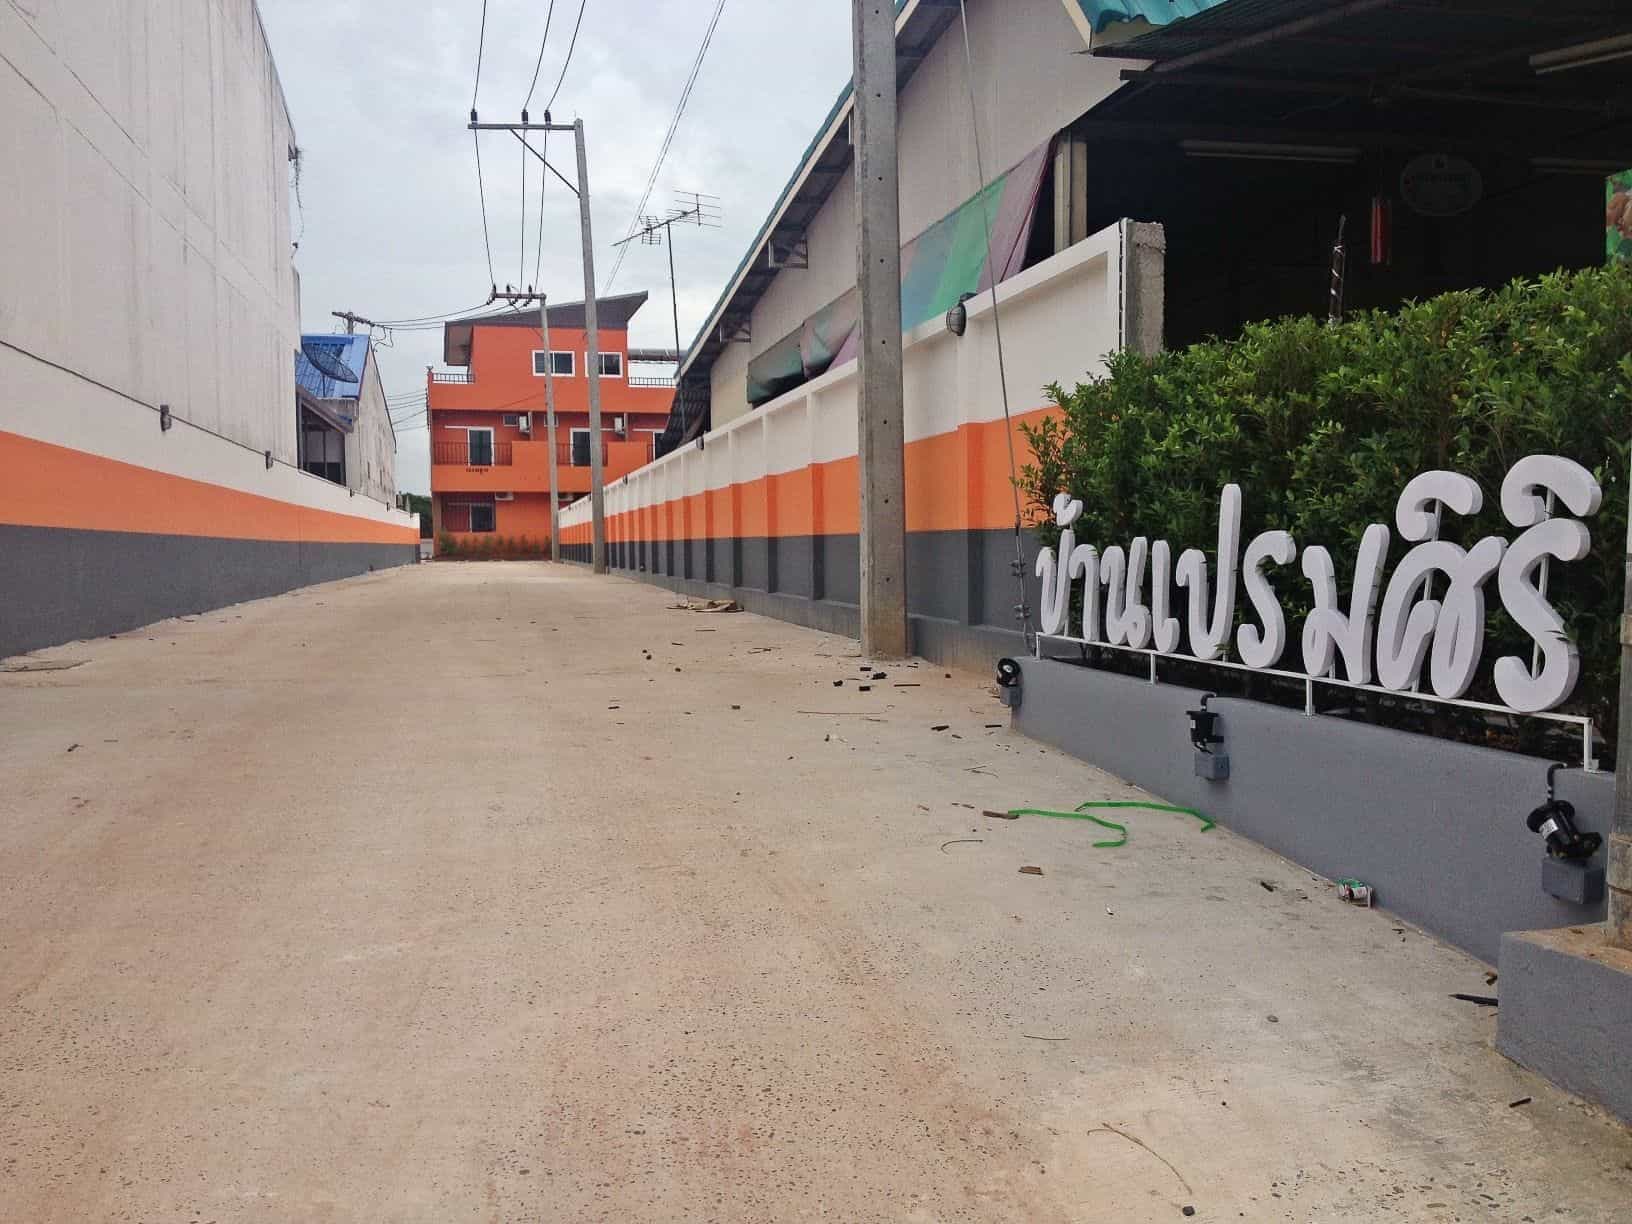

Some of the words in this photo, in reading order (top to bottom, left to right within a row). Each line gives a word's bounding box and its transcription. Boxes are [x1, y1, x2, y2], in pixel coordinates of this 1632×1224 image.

[1036, 454, 1602, 713] บ้านเปรมศิริ
